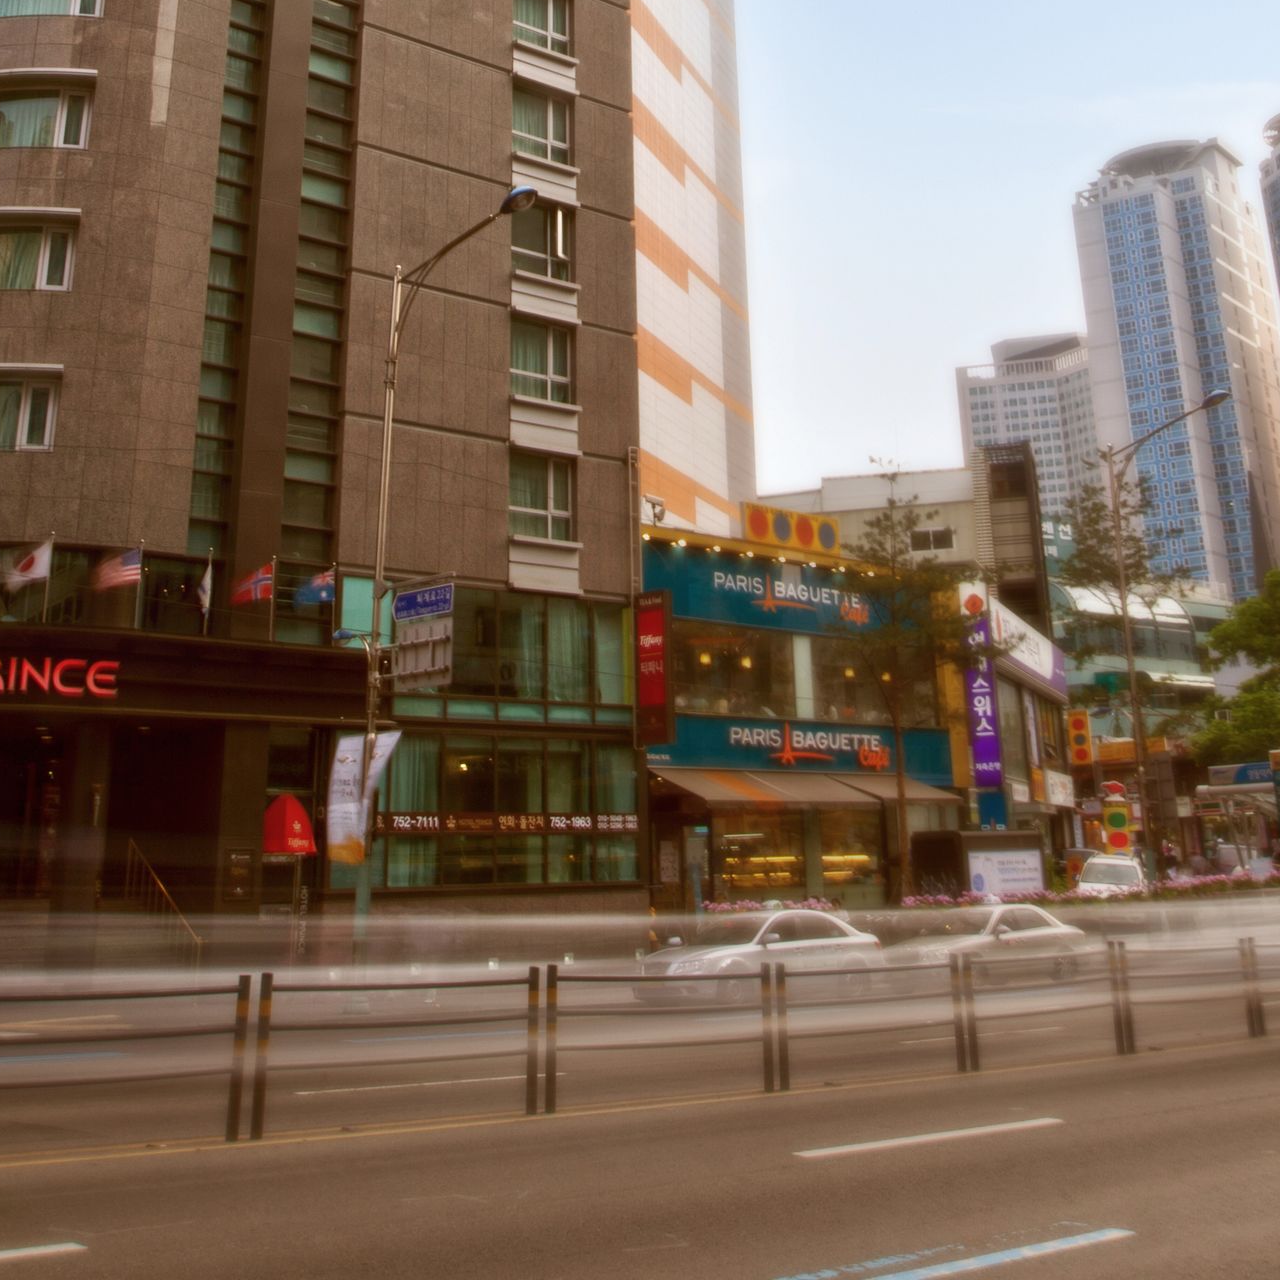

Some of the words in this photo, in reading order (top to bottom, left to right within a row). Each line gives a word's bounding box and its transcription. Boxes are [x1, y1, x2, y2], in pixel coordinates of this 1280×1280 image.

[712, 571, 765, 596] PARIS
[773, 580, 862, 608] BAGUETTE
[639, 634, 664, 648] Tiffany
[728, 726, 782, 748] PARIS
[791, 730, 883, 752] BAGUETTE
[392, 815, 440, 828] 752-7111
[549, 815, 592, 829] 752-1963
